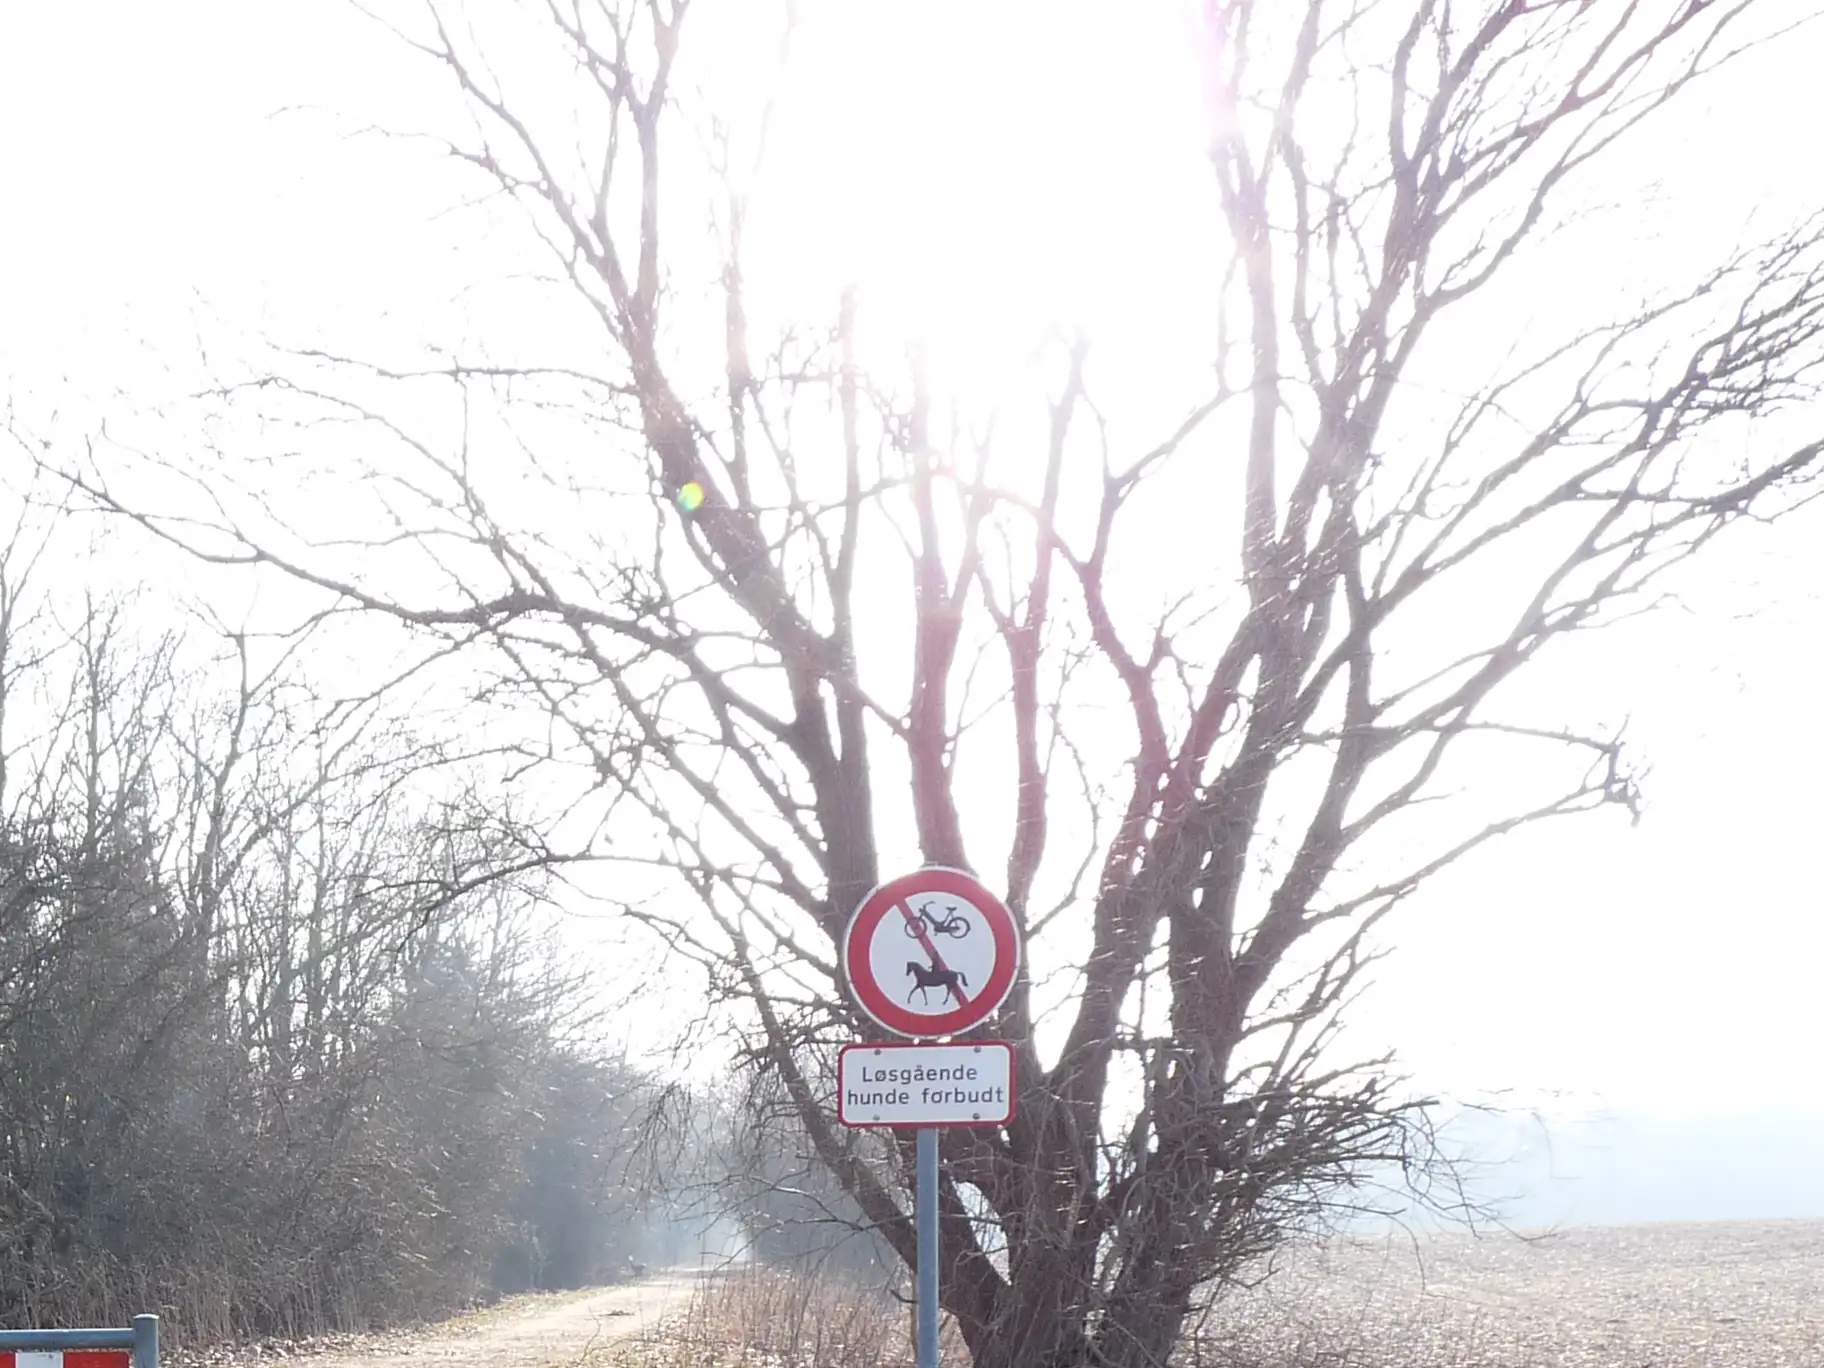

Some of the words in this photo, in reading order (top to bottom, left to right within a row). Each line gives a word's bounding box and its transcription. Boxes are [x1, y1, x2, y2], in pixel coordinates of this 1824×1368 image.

[862, 1064, 978, 1085] Løsgående
[847, 1089, 910, 1105] hunde
[921, 1086, 1005, 1104] forbudt
